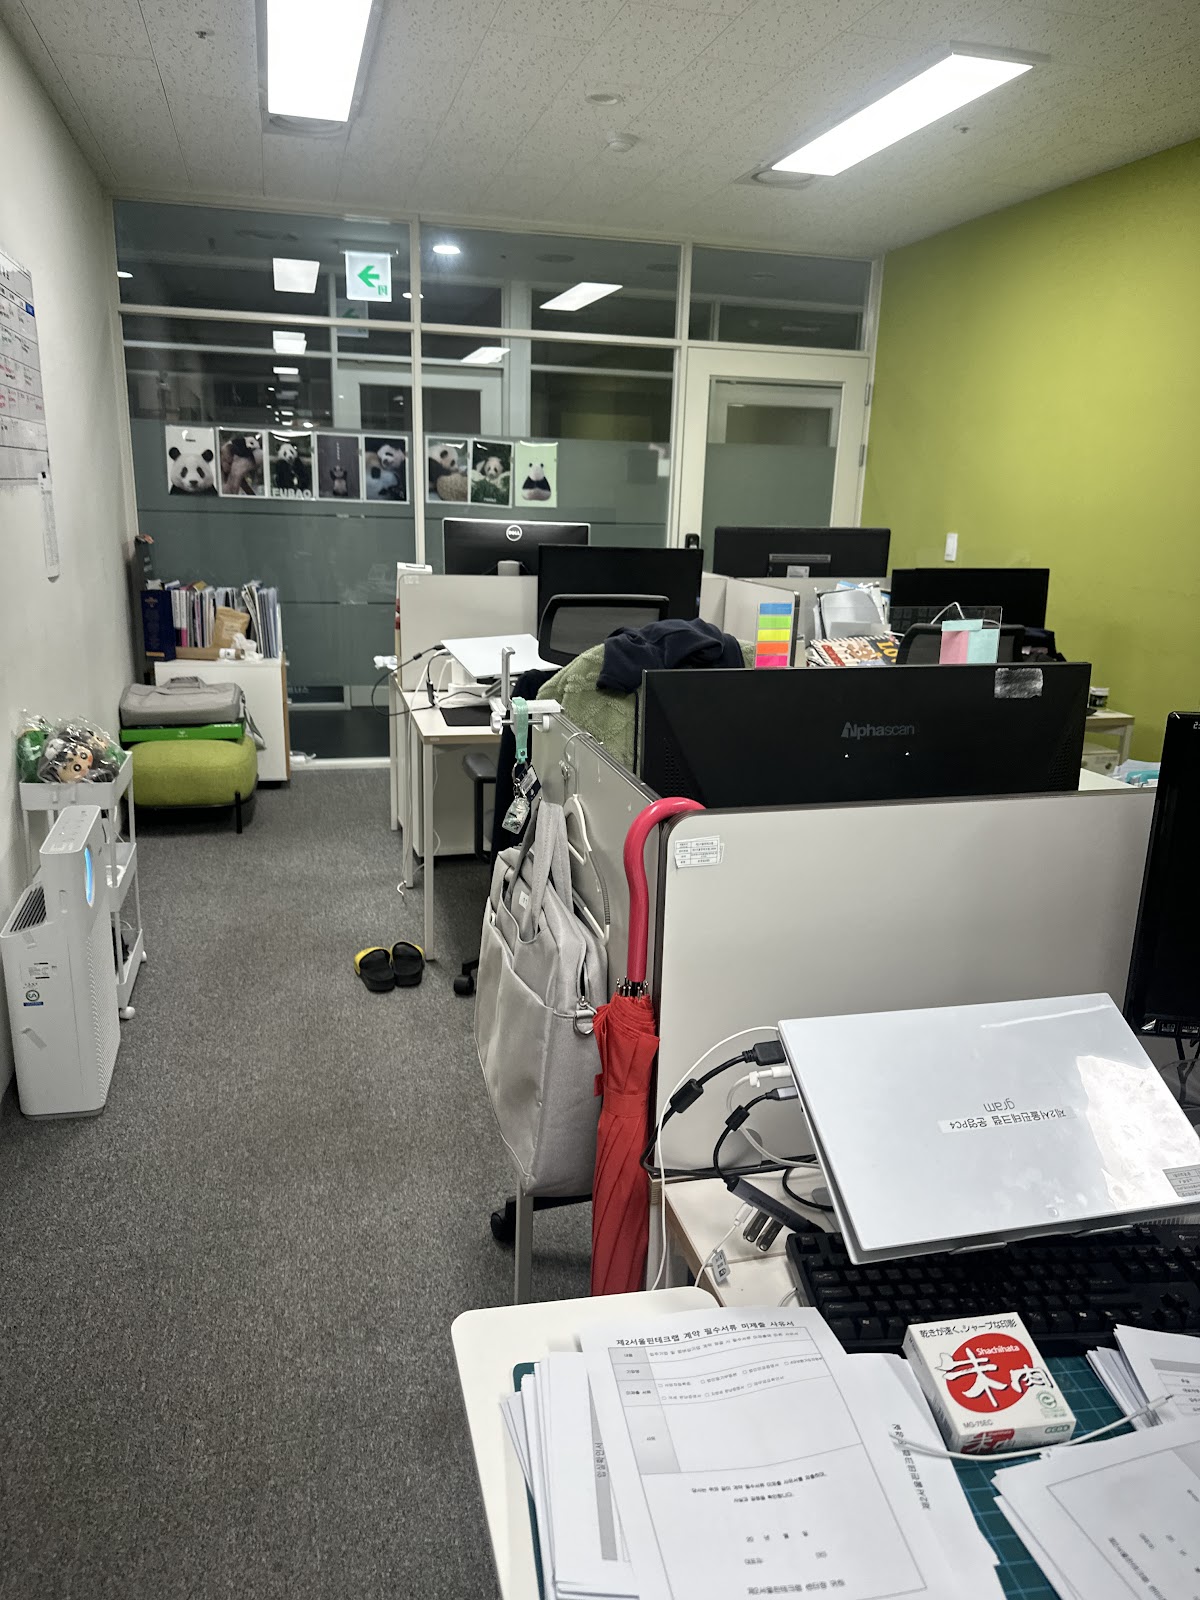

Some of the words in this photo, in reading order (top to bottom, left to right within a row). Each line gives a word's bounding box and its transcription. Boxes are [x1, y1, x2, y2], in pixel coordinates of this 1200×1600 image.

[840, 721, 915, 740] Alphascan
[983, 1097, 1015, 1113] gram
[949, 1116, 988, 1130] 운영PC4
[991, 1108, 1067, 1126] 제2서울핀테크랩
[615, 1332, 681, 1347] 제2서울핀테크랩
[683, 1328, 701, 1341] 계약
[704, 1322, 738, 1336] 필수서류
[741, 1320, 766, 1331] 미제출
[770, 1319, 795, 1329] 사유서
[976, 1344, 1021, 1356] Shachihata
